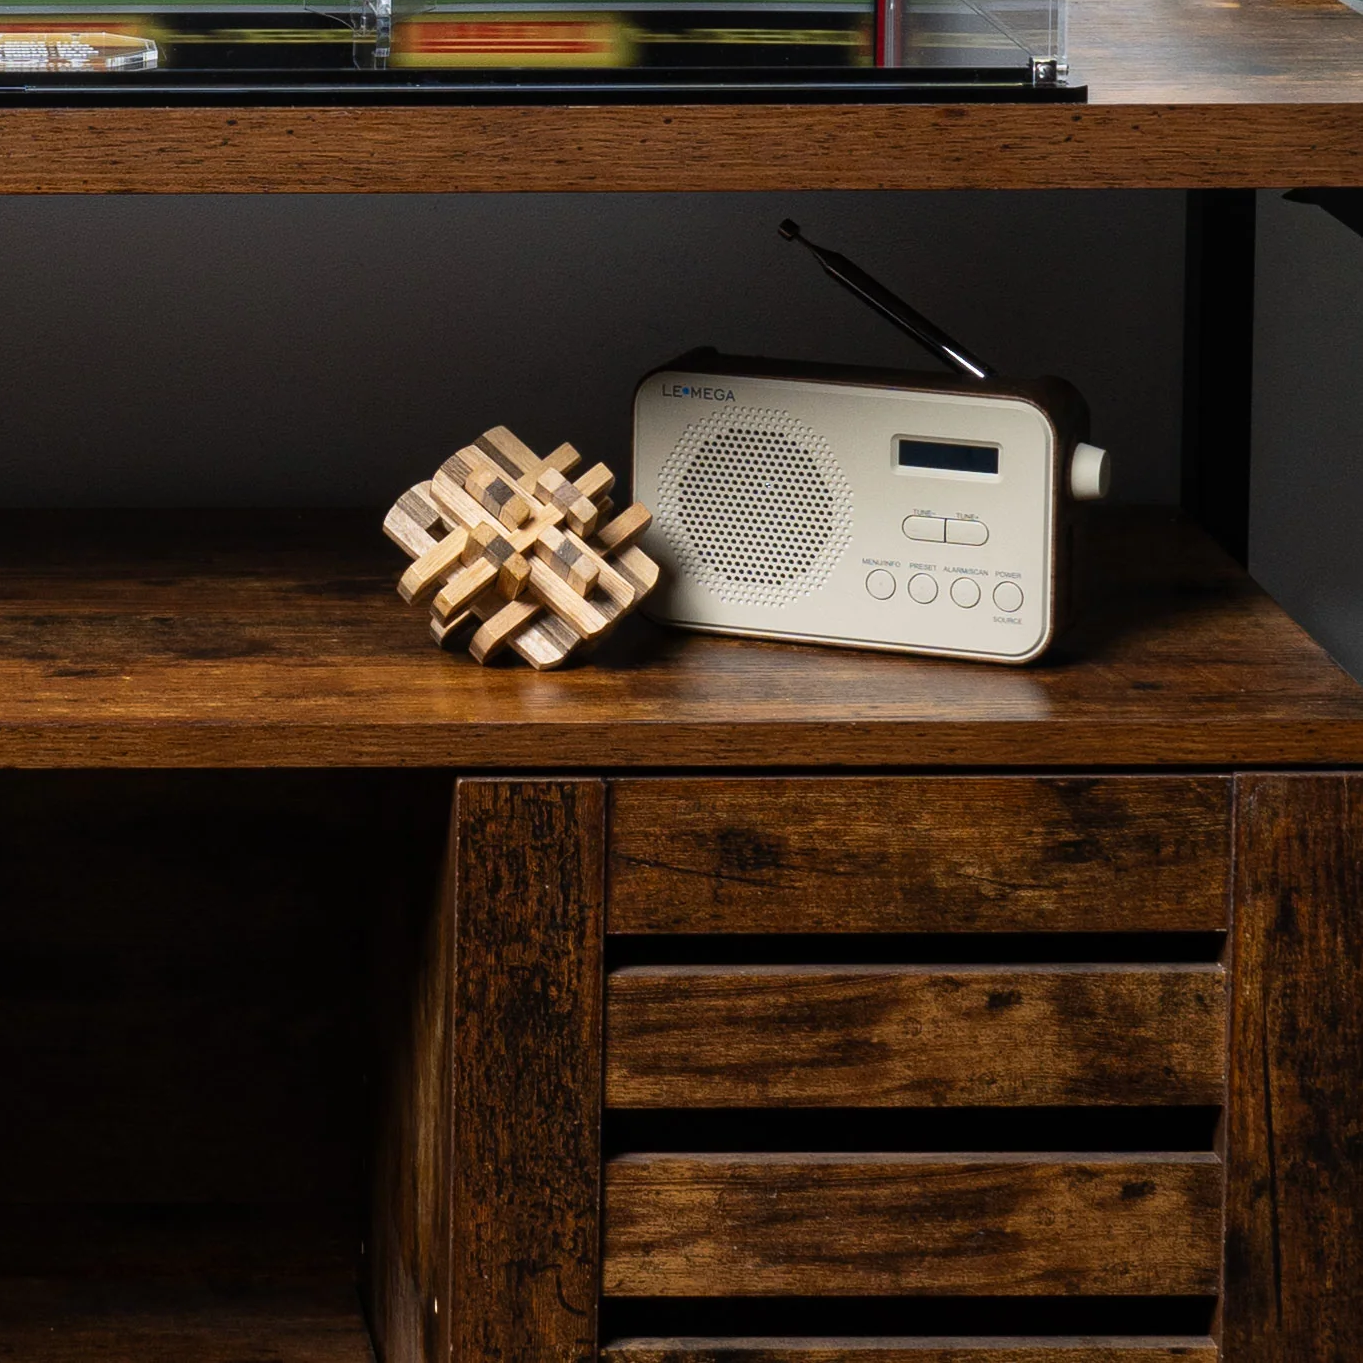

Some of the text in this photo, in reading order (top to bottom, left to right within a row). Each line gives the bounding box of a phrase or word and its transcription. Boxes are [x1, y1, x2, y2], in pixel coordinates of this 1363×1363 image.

[909, 562, 937, 572] PRESET
[994, 570, 1022, 579] POWER
[992, 615, 1023, 626] SOURCE
